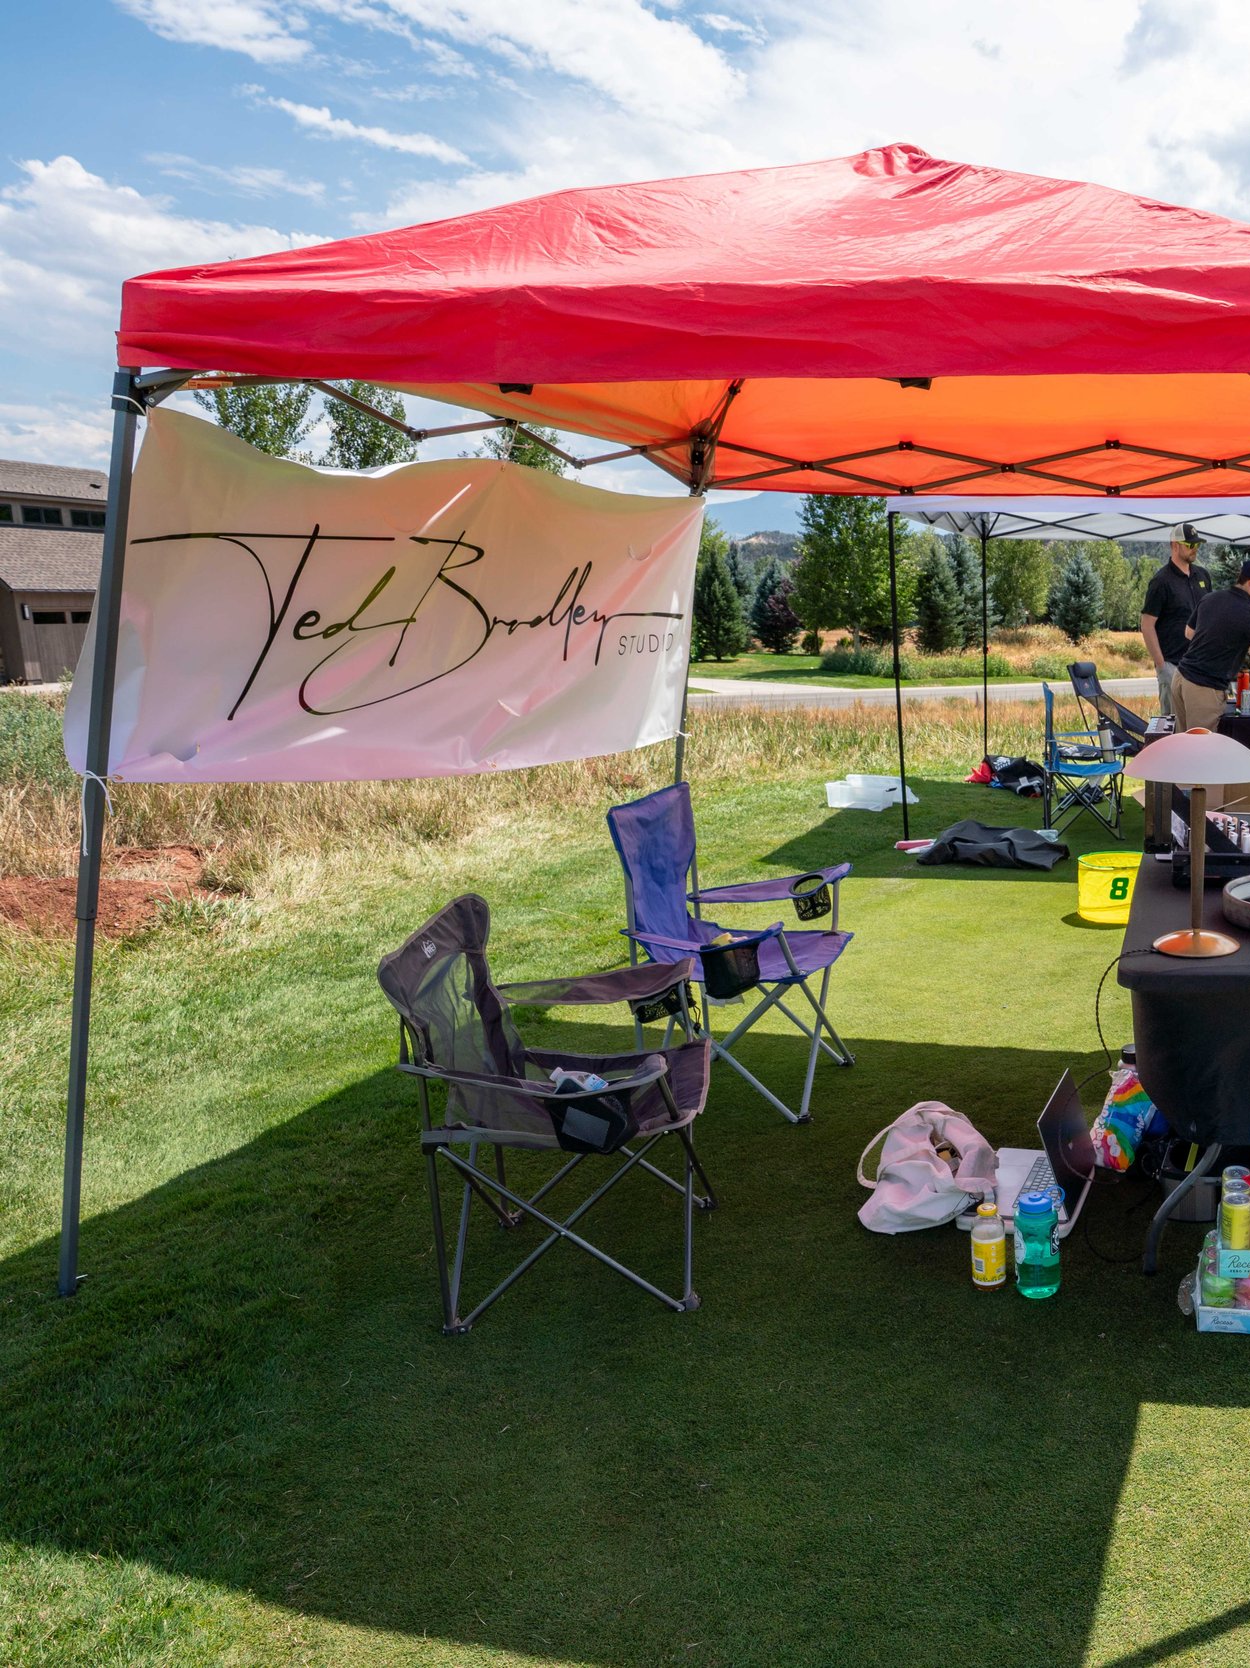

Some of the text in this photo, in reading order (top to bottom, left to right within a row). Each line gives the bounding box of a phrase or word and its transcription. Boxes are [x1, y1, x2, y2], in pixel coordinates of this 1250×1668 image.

[131, 524, 684, 720] Ted Bradley
[618, 633, 674, 655] STUDIO
[1109, 877, 1130, 900] 8
[1210, 1316, 1234, 1326] Recess
